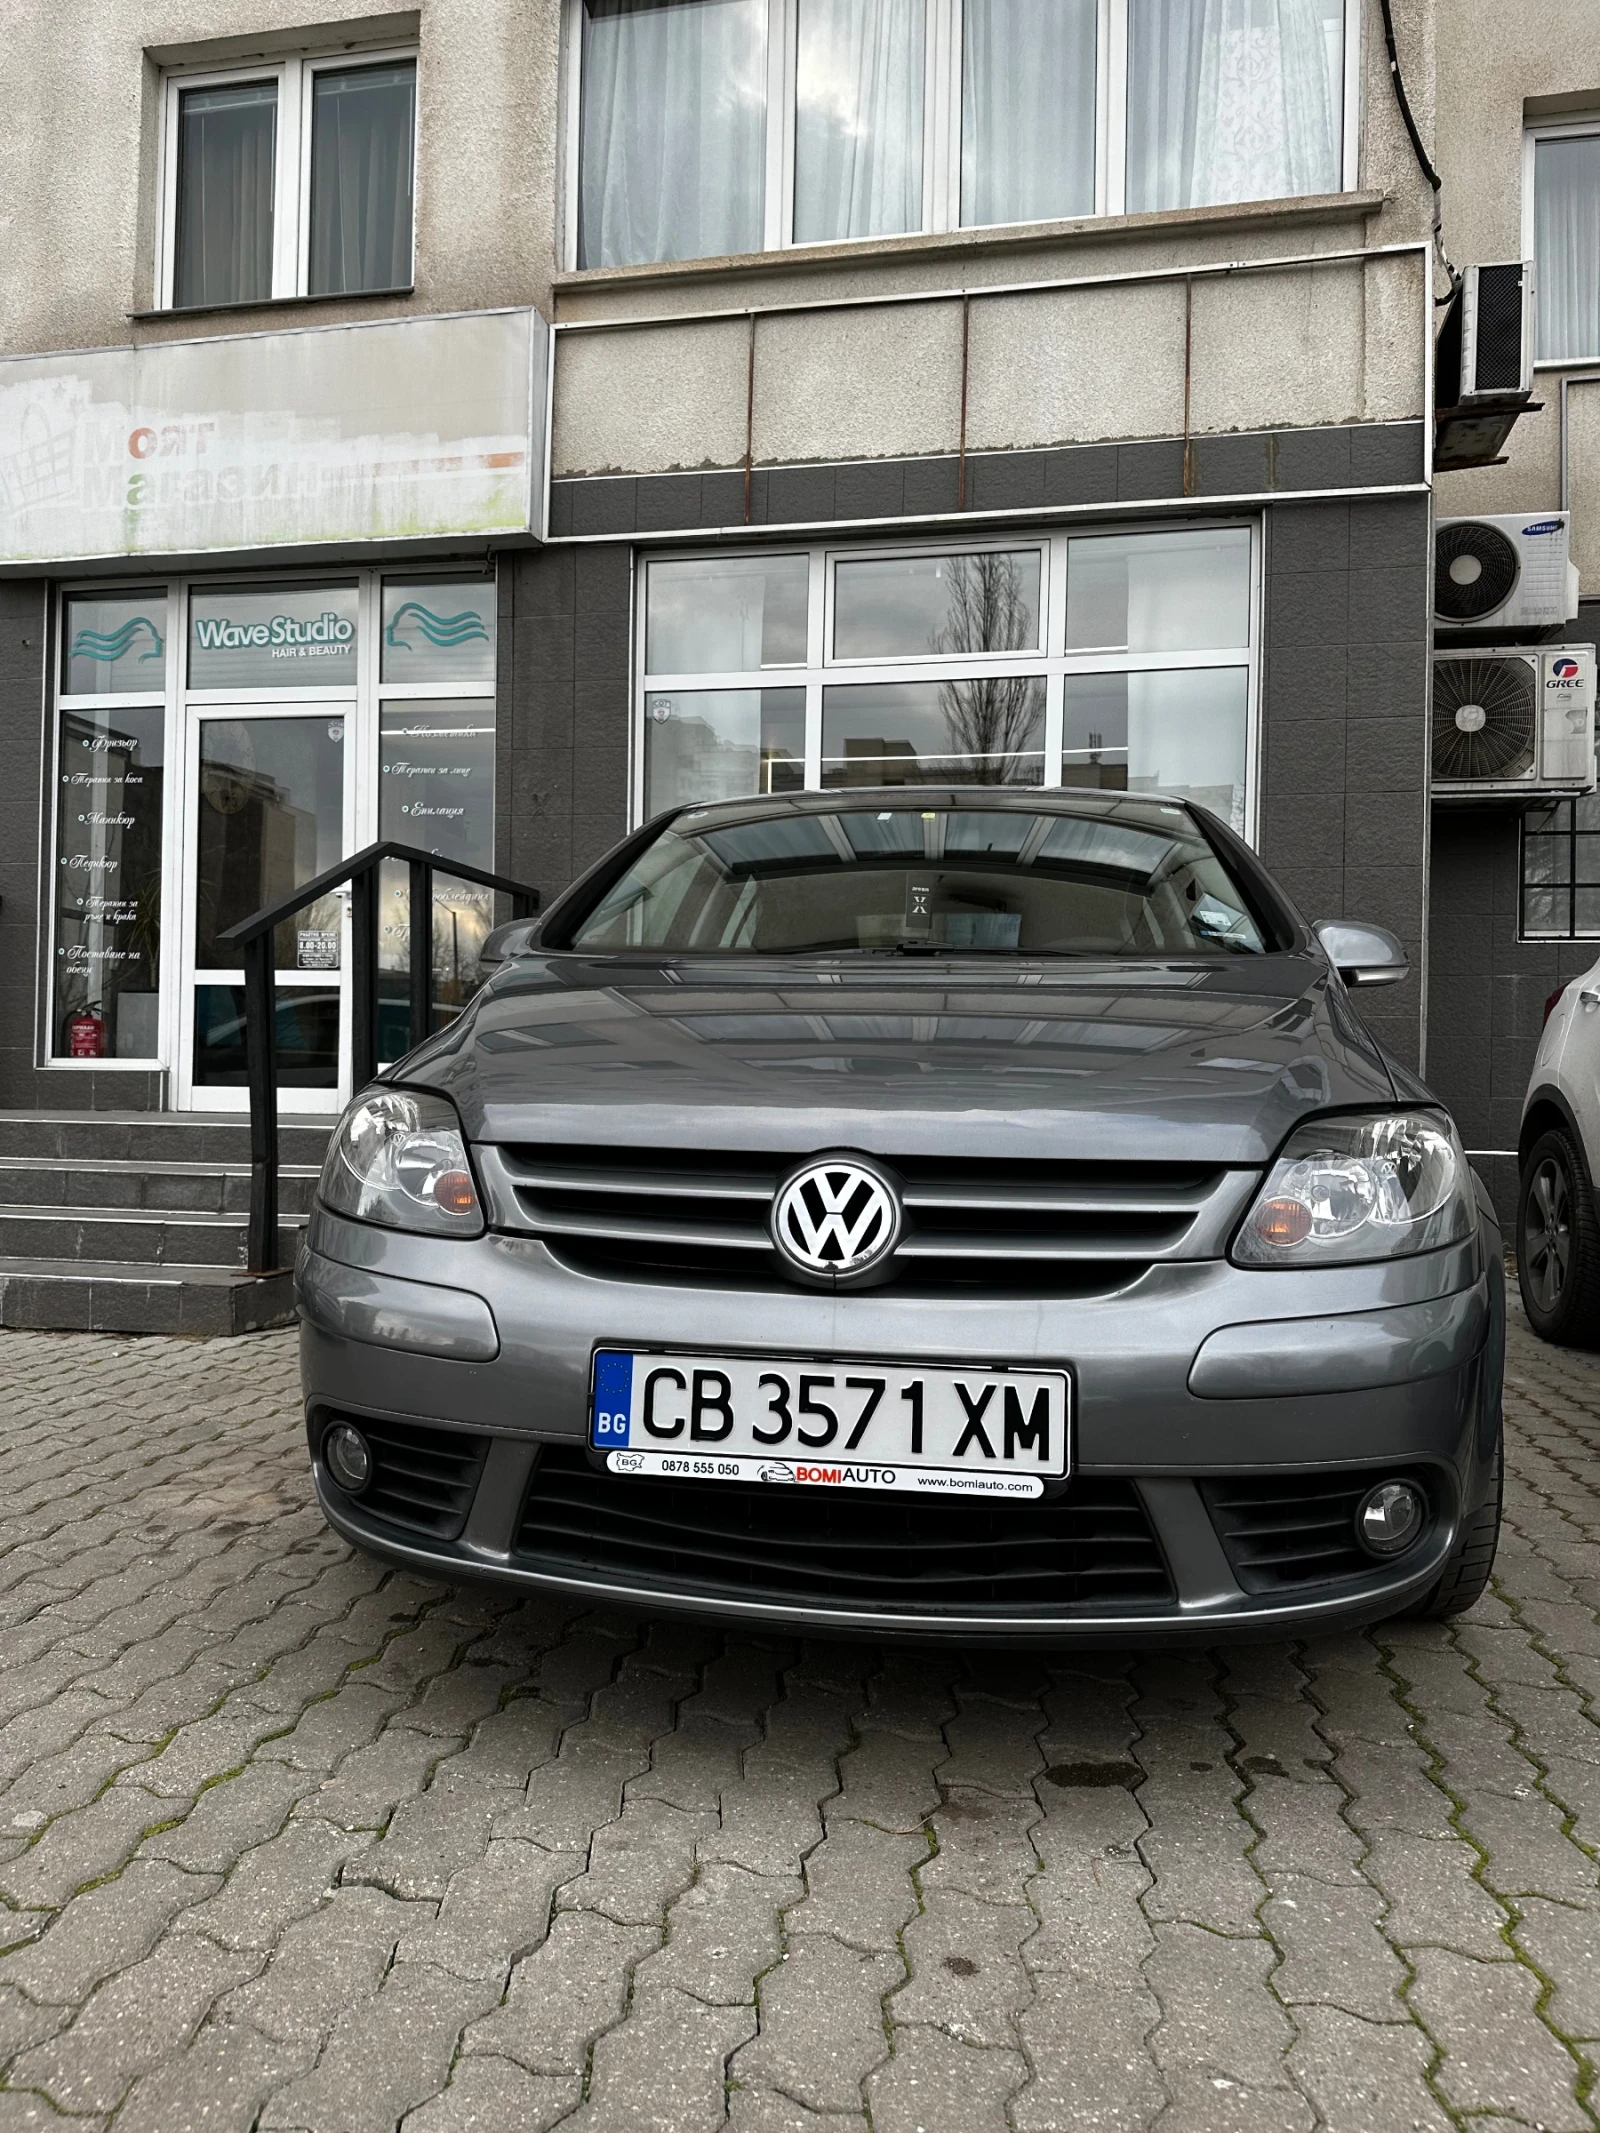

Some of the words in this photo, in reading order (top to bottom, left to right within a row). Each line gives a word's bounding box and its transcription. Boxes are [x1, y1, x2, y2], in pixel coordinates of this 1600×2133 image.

[271, 648, 297, 658] HAIR
[298, 648, 307, 657] &
[308, 645, 352, 656] BEAUTY
[1546, 679, 1585, 688] GREE
[89, 735, 138, 752] Фризьор
[124, 772, 143, 783] коса
[450, 767, 471, 777] лице
[410, 801, 465, 819] Епилация
[84, 811, 135, 829] Маникюр
[69, 854, 118, 872] Педикюр
[128, 900, 139, 908] за
[112, 910, 137, 924] крака
[67, 945, 126, 959] Поставяне
[128, 951, 141, 959] на
[66, 961, 93, 977] обеци
[597, 1411, 627, 1435] BG
[752, 1372, 925, 1454] 3571
[621, 1458, 638, 1467] BG
[661, 1459, 691, 1473] 0878
[693, 1461, 715, 1474] 555
[717, 1463, 740, 1476] 050
[917, 1477, 1034, 1492] www.bomiauto.com
